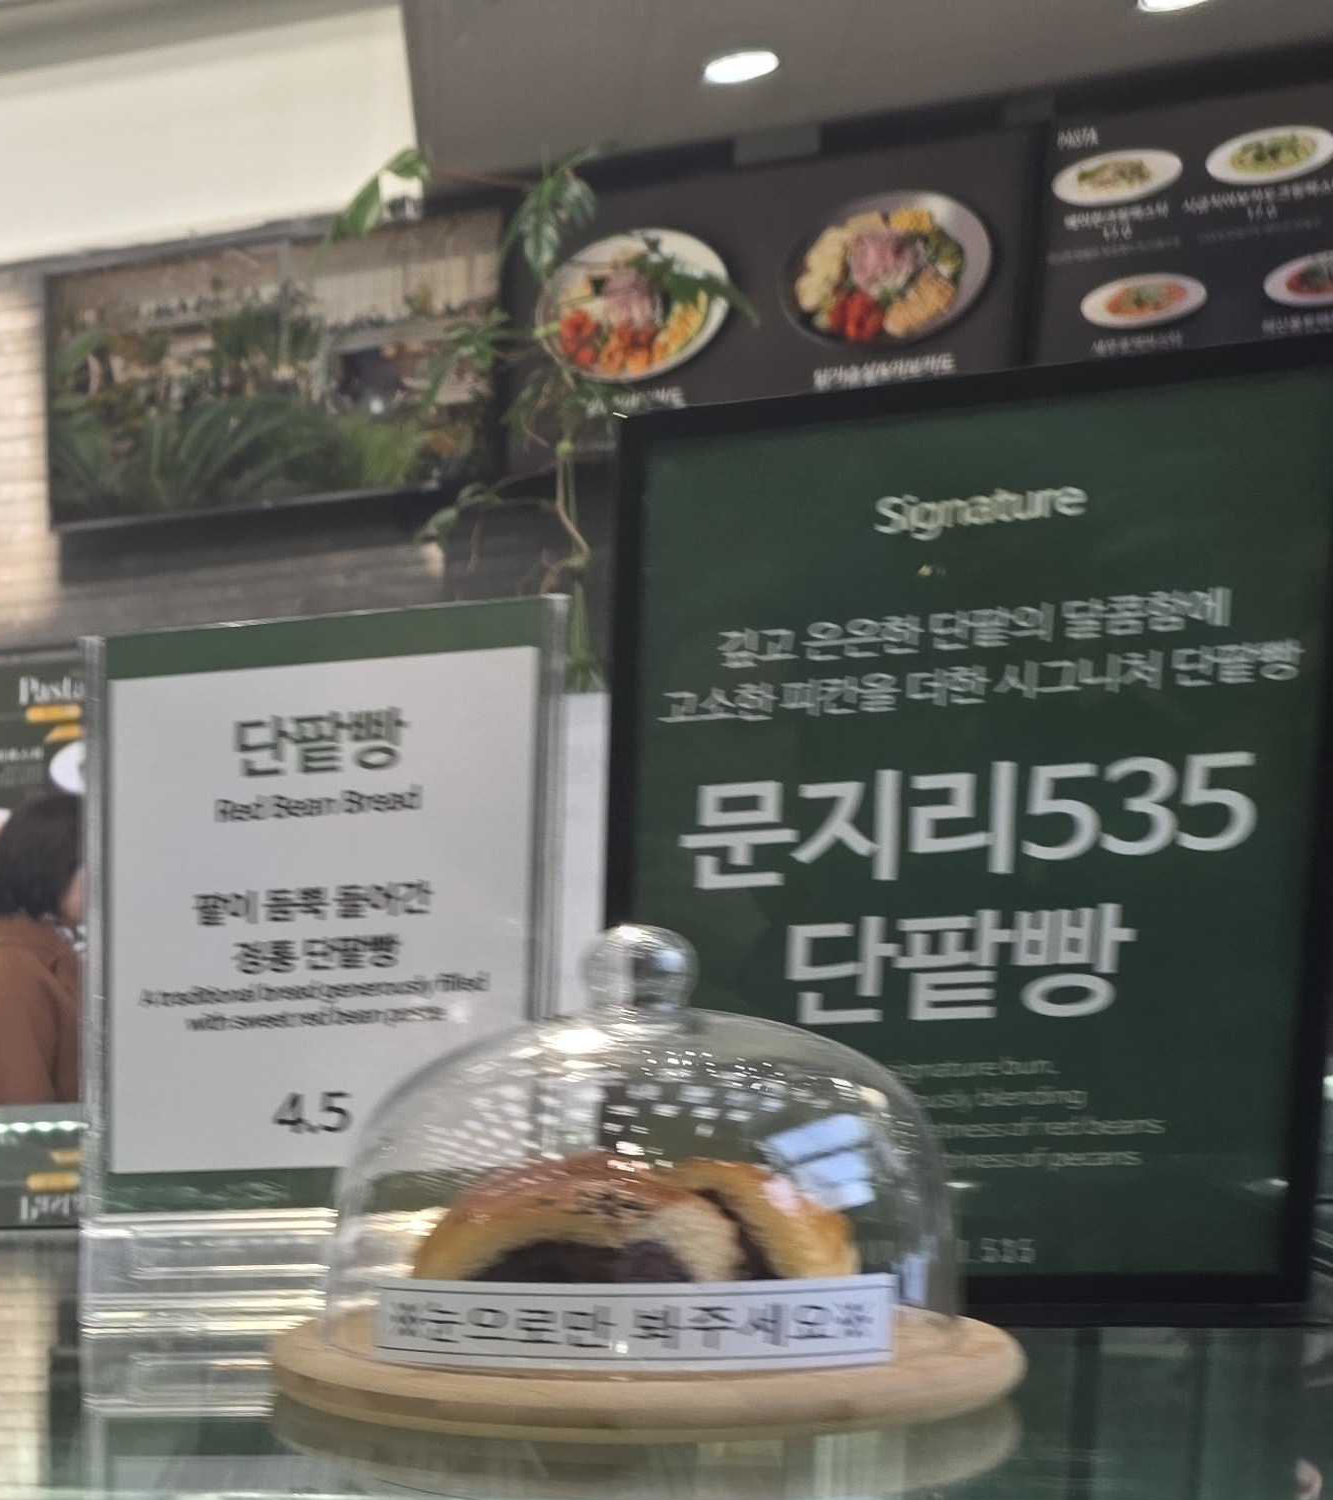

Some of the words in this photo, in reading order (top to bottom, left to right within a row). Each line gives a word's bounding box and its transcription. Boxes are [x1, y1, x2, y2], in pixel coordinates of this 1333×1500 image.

[874, 485, 1087, 540] Signature
[800, 614, 926, 661] 은은한
[928, 602, 1055, 651] 단팥의
[1060, 586, 1232, 640] 달콤함에
[657, 681, 779, 723] 고소한
[905, 664, 992, 707] 더한
[992, 649, 1164, 700] 시그니처
[1171, 637, 1306, 687] 단팥빵
[233, 706, 411, 778] 단팥빵
[214, 795, 270, 822] Red
[271, 793, 338, 820] Bean
[340, 783, 424, 814] Bread
[678, 750, 1258, 890] 문지리535
[192, 888, 259, 927] 팥이
[261, 886, 330, 923] 듬뿍
[330, 879, 435, 919] 들어간
[301, 932, 403, 971] 단팥빵
[785, 902, 1137, 1025] 단팥빵
[272, 1091, 353, 1135] 4.5
